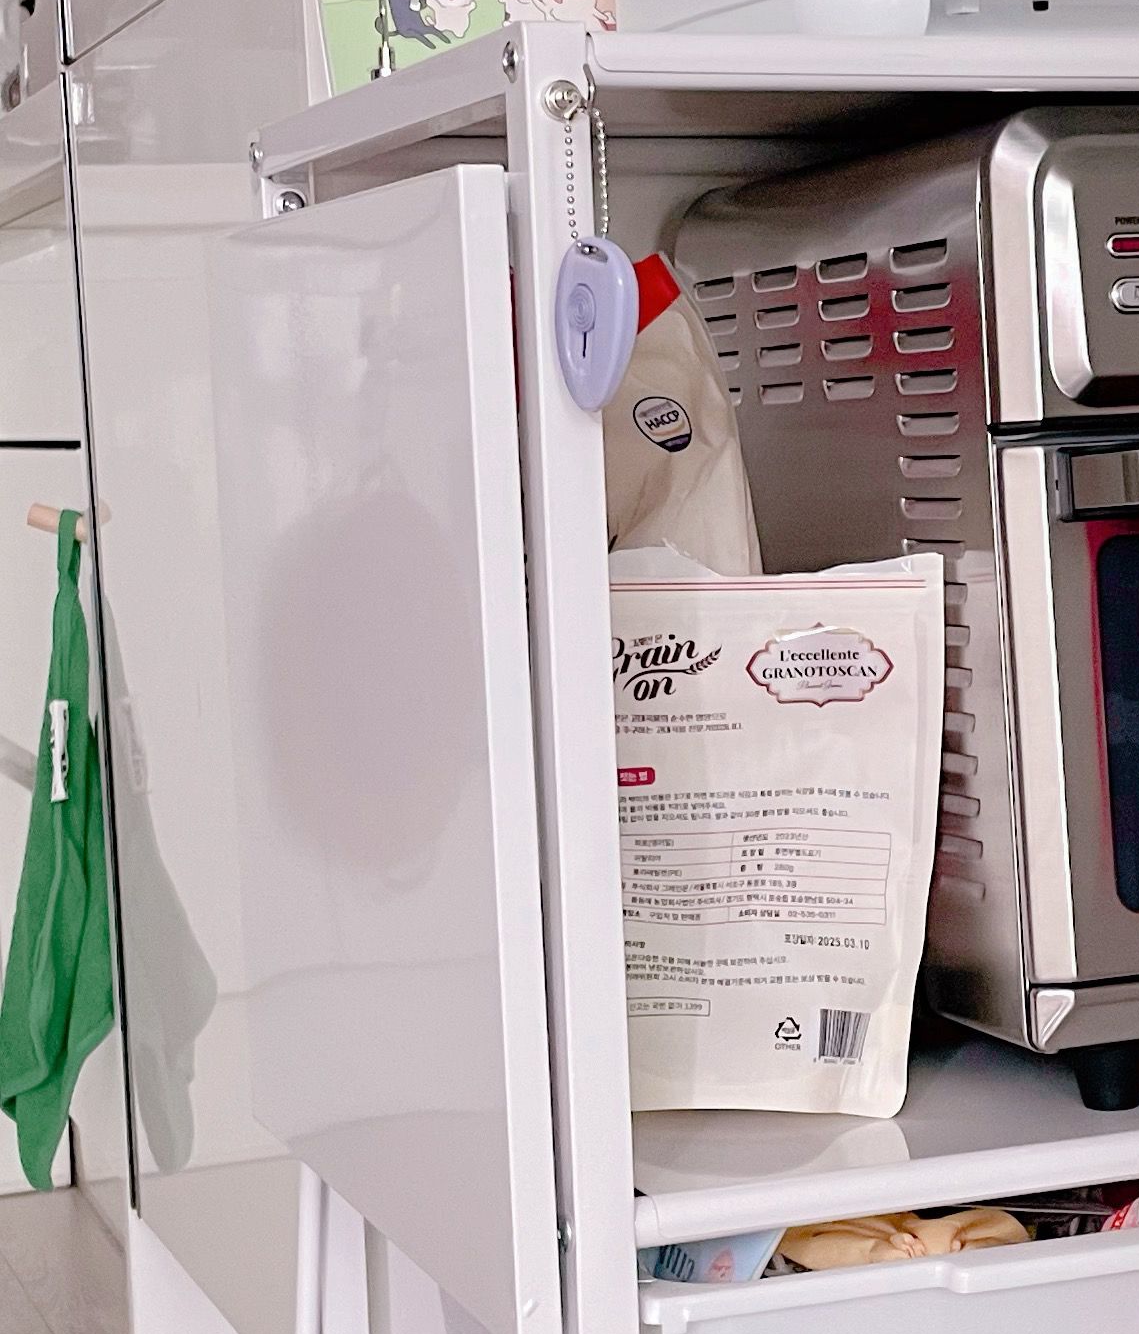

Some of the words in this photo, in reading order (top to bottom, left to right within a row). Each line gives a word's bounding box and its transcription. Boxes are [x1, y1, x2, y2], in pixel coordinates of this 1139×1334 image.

[644, 409, 680, 431] HACCP
[761, 665, 877, 679] GRANOTOSCAN
[633, 676, 677, 701] on
[774, 1042, 801, 1052] OTHER
